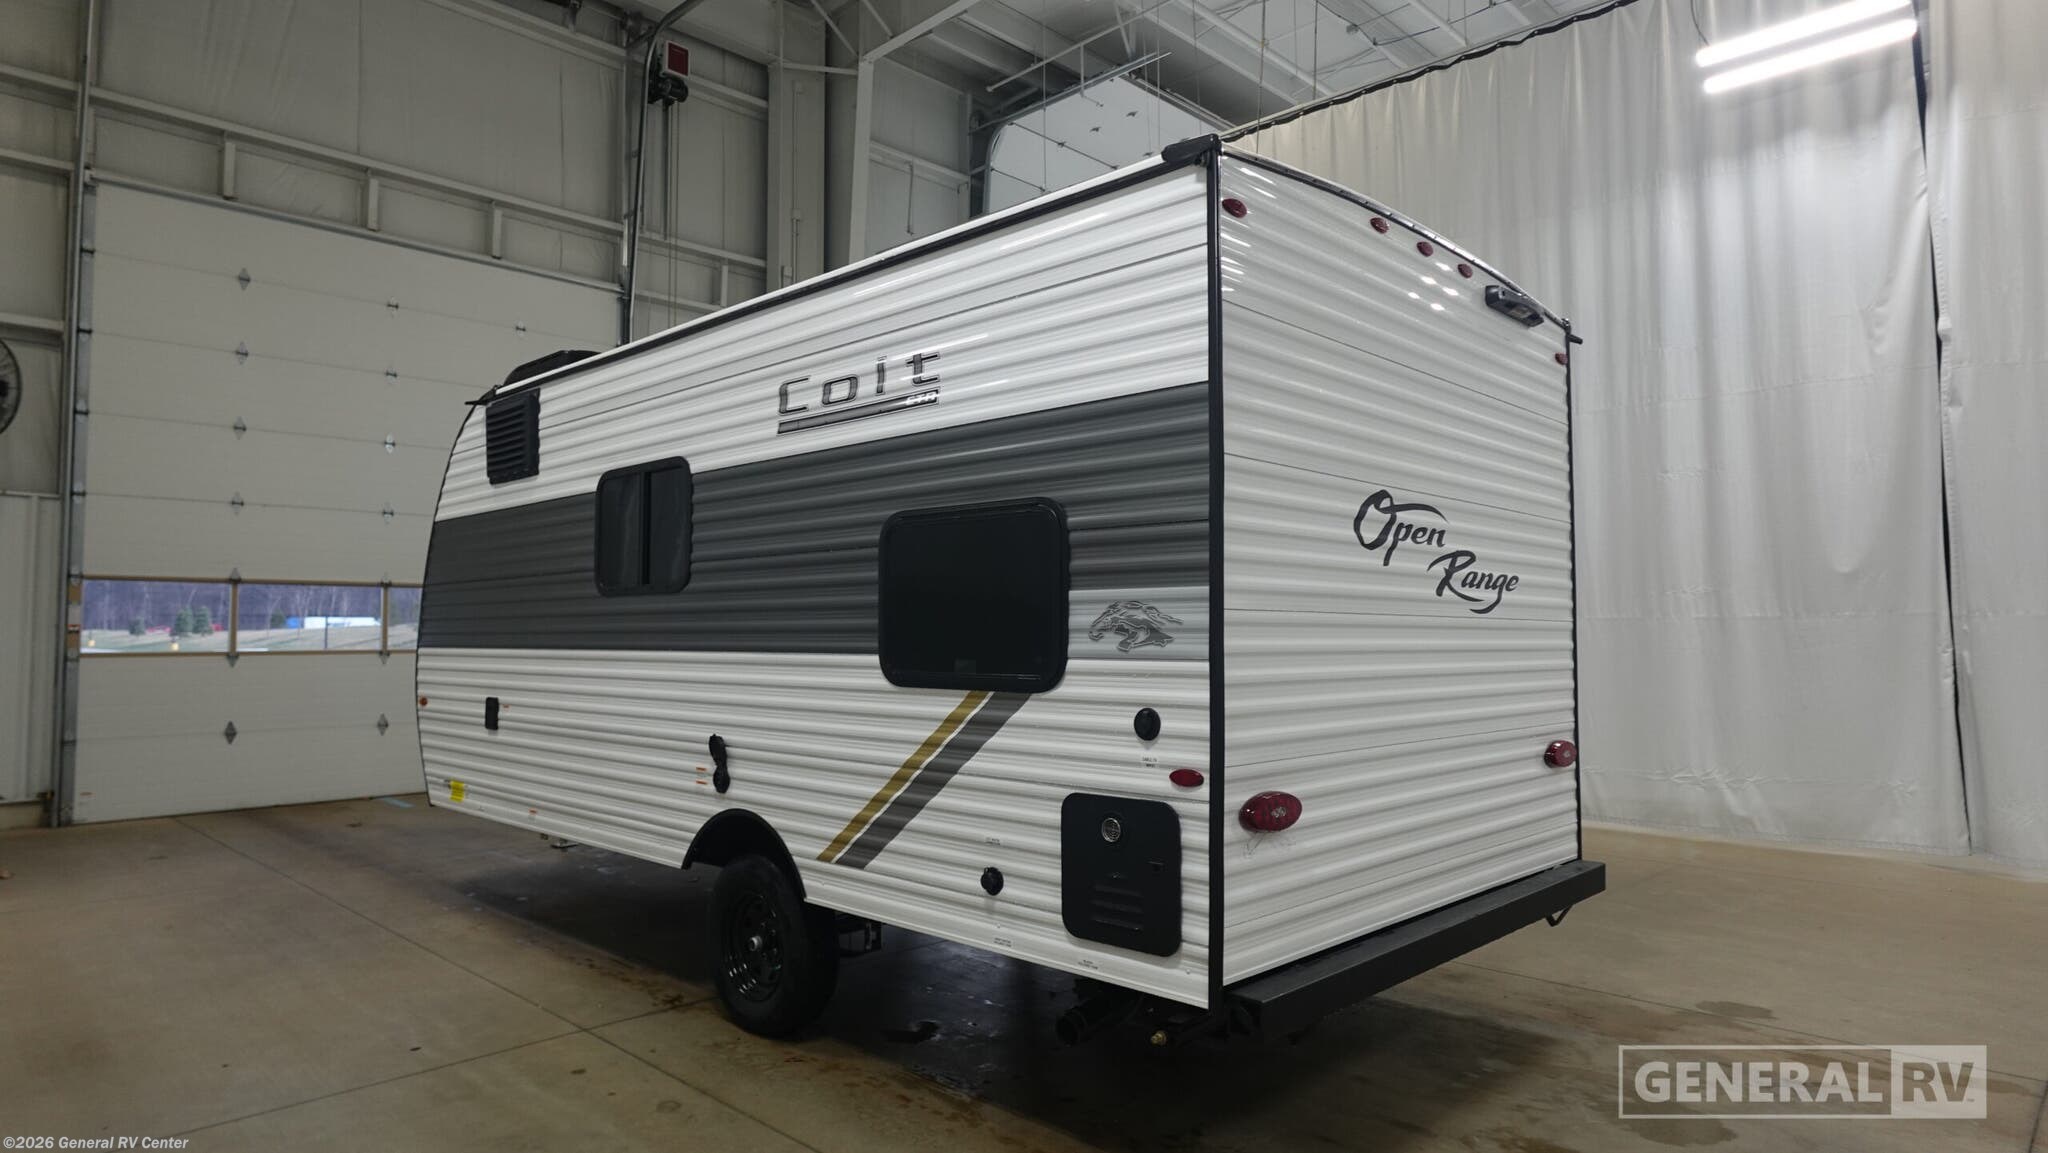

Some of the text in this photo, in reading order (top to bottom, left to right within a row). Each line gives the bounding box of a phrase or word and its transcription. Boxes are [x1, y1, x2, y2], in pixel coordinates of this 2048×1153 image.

[779, 353, 940, 415] Colt
[1353, 489, 1449, 567] Open
[1426, 550, 1520, 614] Range
